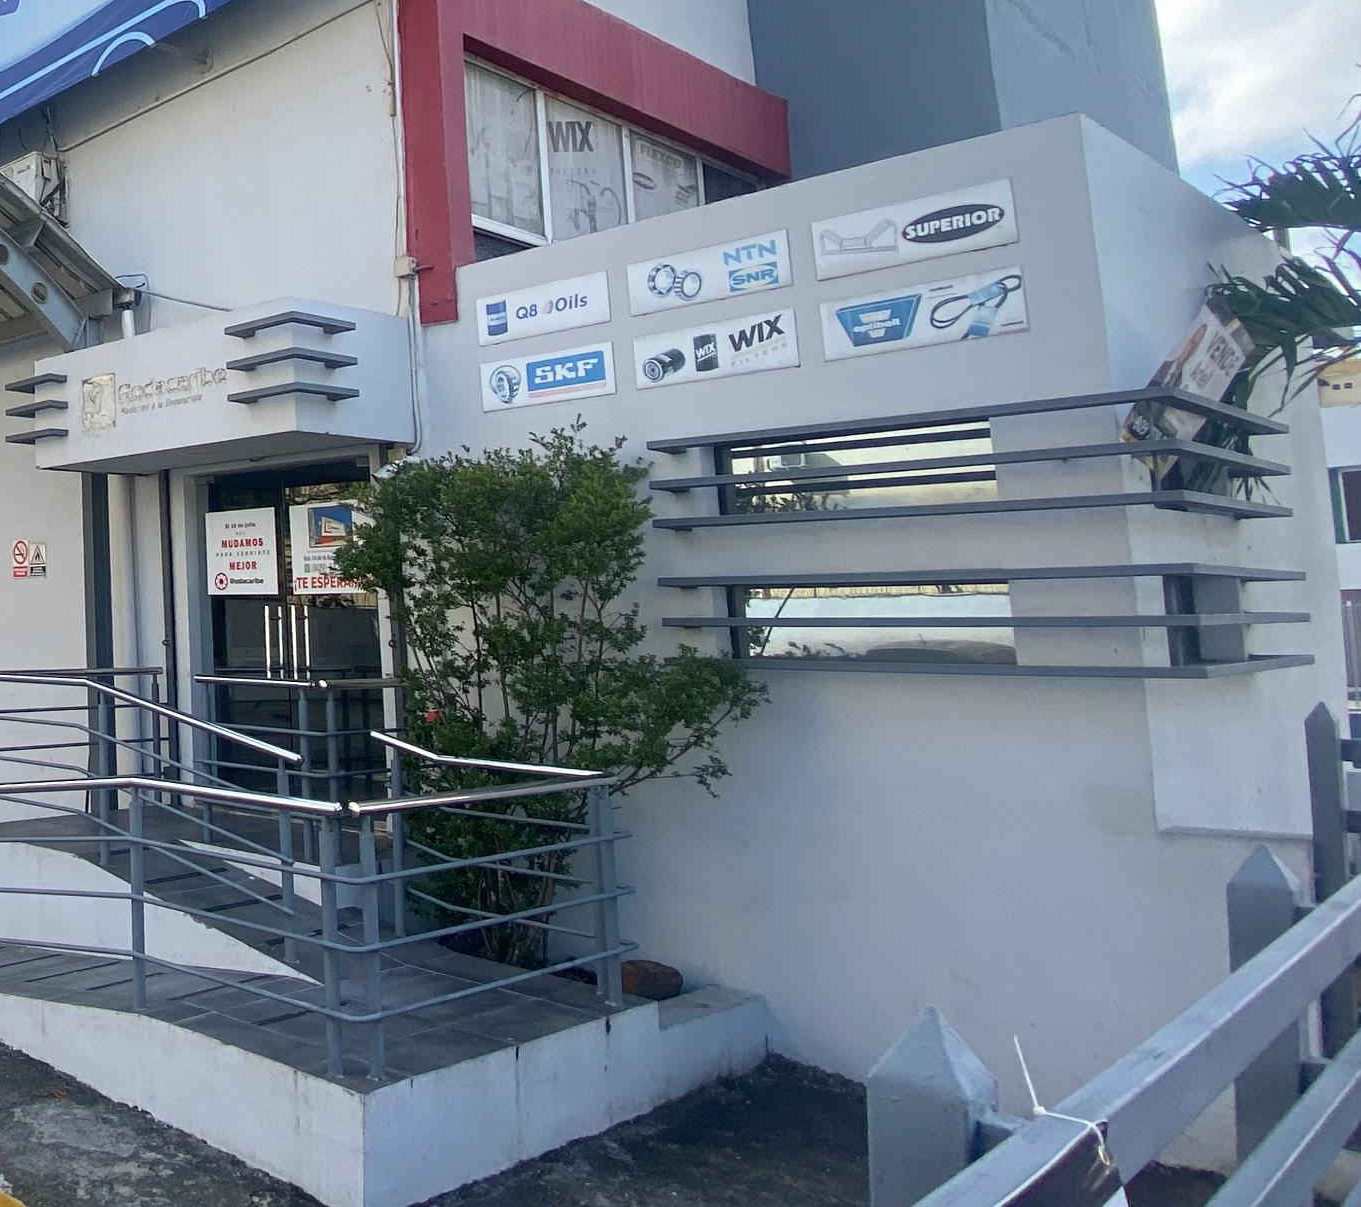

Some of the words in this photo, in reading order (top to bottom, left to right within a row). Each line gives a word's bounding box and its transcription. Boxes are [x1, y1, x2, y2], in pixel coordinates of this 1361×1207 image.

[547, 120, 595, 153] WIX
[904, 207, 1003, 240] SUPERIOR
[723, 239, 777, 266] NTN
[732, 268, 775, 286] SNR
[516, 303, 538, 320] Q8
[554, 294, 588, 312] Oils
[728, 314, 785, 353] WIX
[695, 342, 717, 359] WIX
[534, 357, 599, 385] SKF
[221, 538, 264, 549] MUDAMOS
[229, 561, 257, 571] MEJOR
